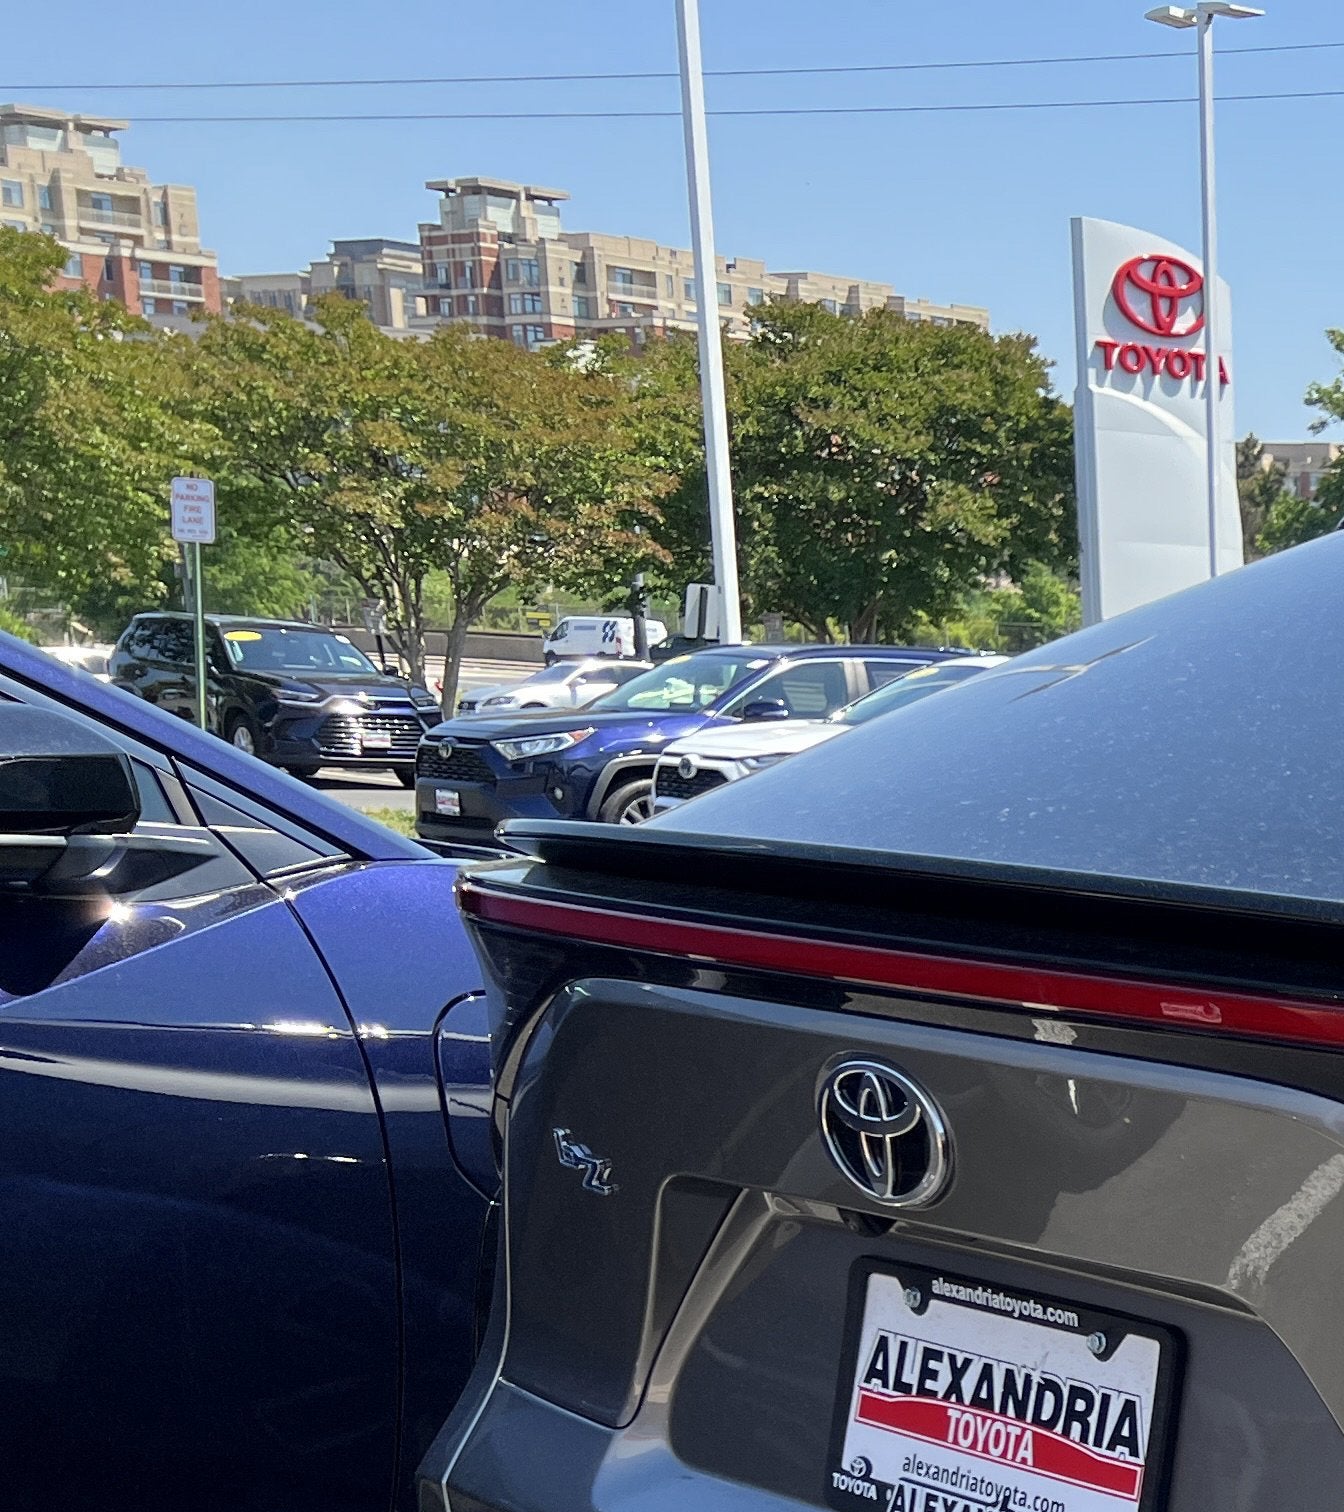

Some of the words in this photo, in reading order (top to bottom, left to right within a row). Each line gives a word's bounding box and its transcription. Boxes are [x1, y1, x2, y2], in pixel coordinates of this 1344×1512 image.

[175, 493, 210, 503] PARKING
[185, 483, 198, 492] NO
[183, 504, 202, 514] FIRE
[930, 1276, 1079, 1328] alexandriatoyota.com
[863, 1335, 1141, 1460] ALEXANDRIA
[946, 1408, 1035, 1467] TOYOTA
[832, 1472, 878, 1501] TOYOTA
